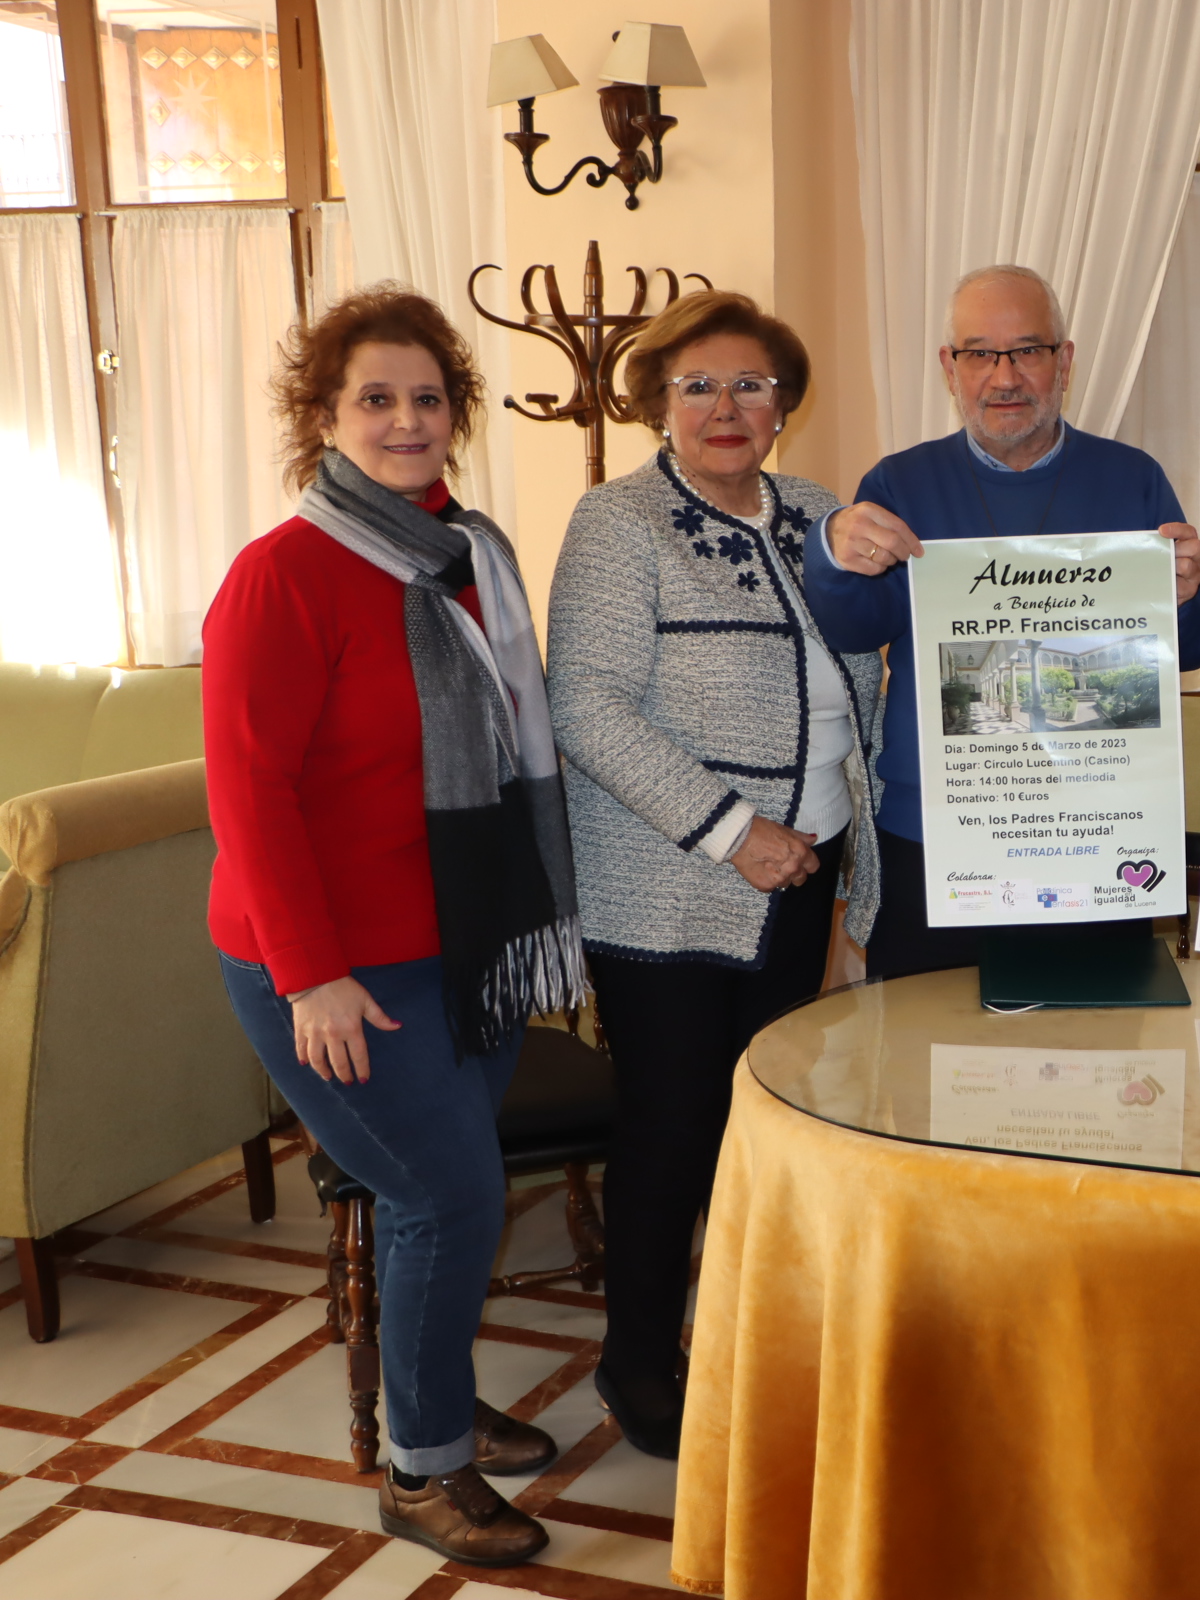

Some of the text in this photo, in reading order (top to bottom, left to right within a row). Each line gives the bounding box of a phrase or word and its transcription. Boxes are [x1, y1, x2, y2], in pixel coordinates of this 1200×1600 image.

[969, 559, 1112, 594] Almuerzo
[993, 594, 1095, 613] a Beneficio de
[952, 617, 1147, 635] RR.PP. Franciscanos
[945, 738, 1126, 755] Día: Domingo 5 de Marzo de 2023
[946, 755, 1130, 772] Lugar: Círculo Lucentino (Casino)
[946, 772, 1116, 787] Hora: 14:00 horas del mediodía
[947, 792, 1049, 804] Donativo: 10 €uros
[958, 810, 1143, 827] Ven, los Padres Franciscanos
[992, 825, 1114, 839] necesitan tu ayuda!
[1007, 846, 1100, 857] ENTRADA LIBRE
[1117, 847, 1159, 857] Organiza:
[947, 872, 997, 882] Colaboran:
[1094, 886, 1132, 895] Mujeres
[1094, 894, 1135, 905] igualdad
